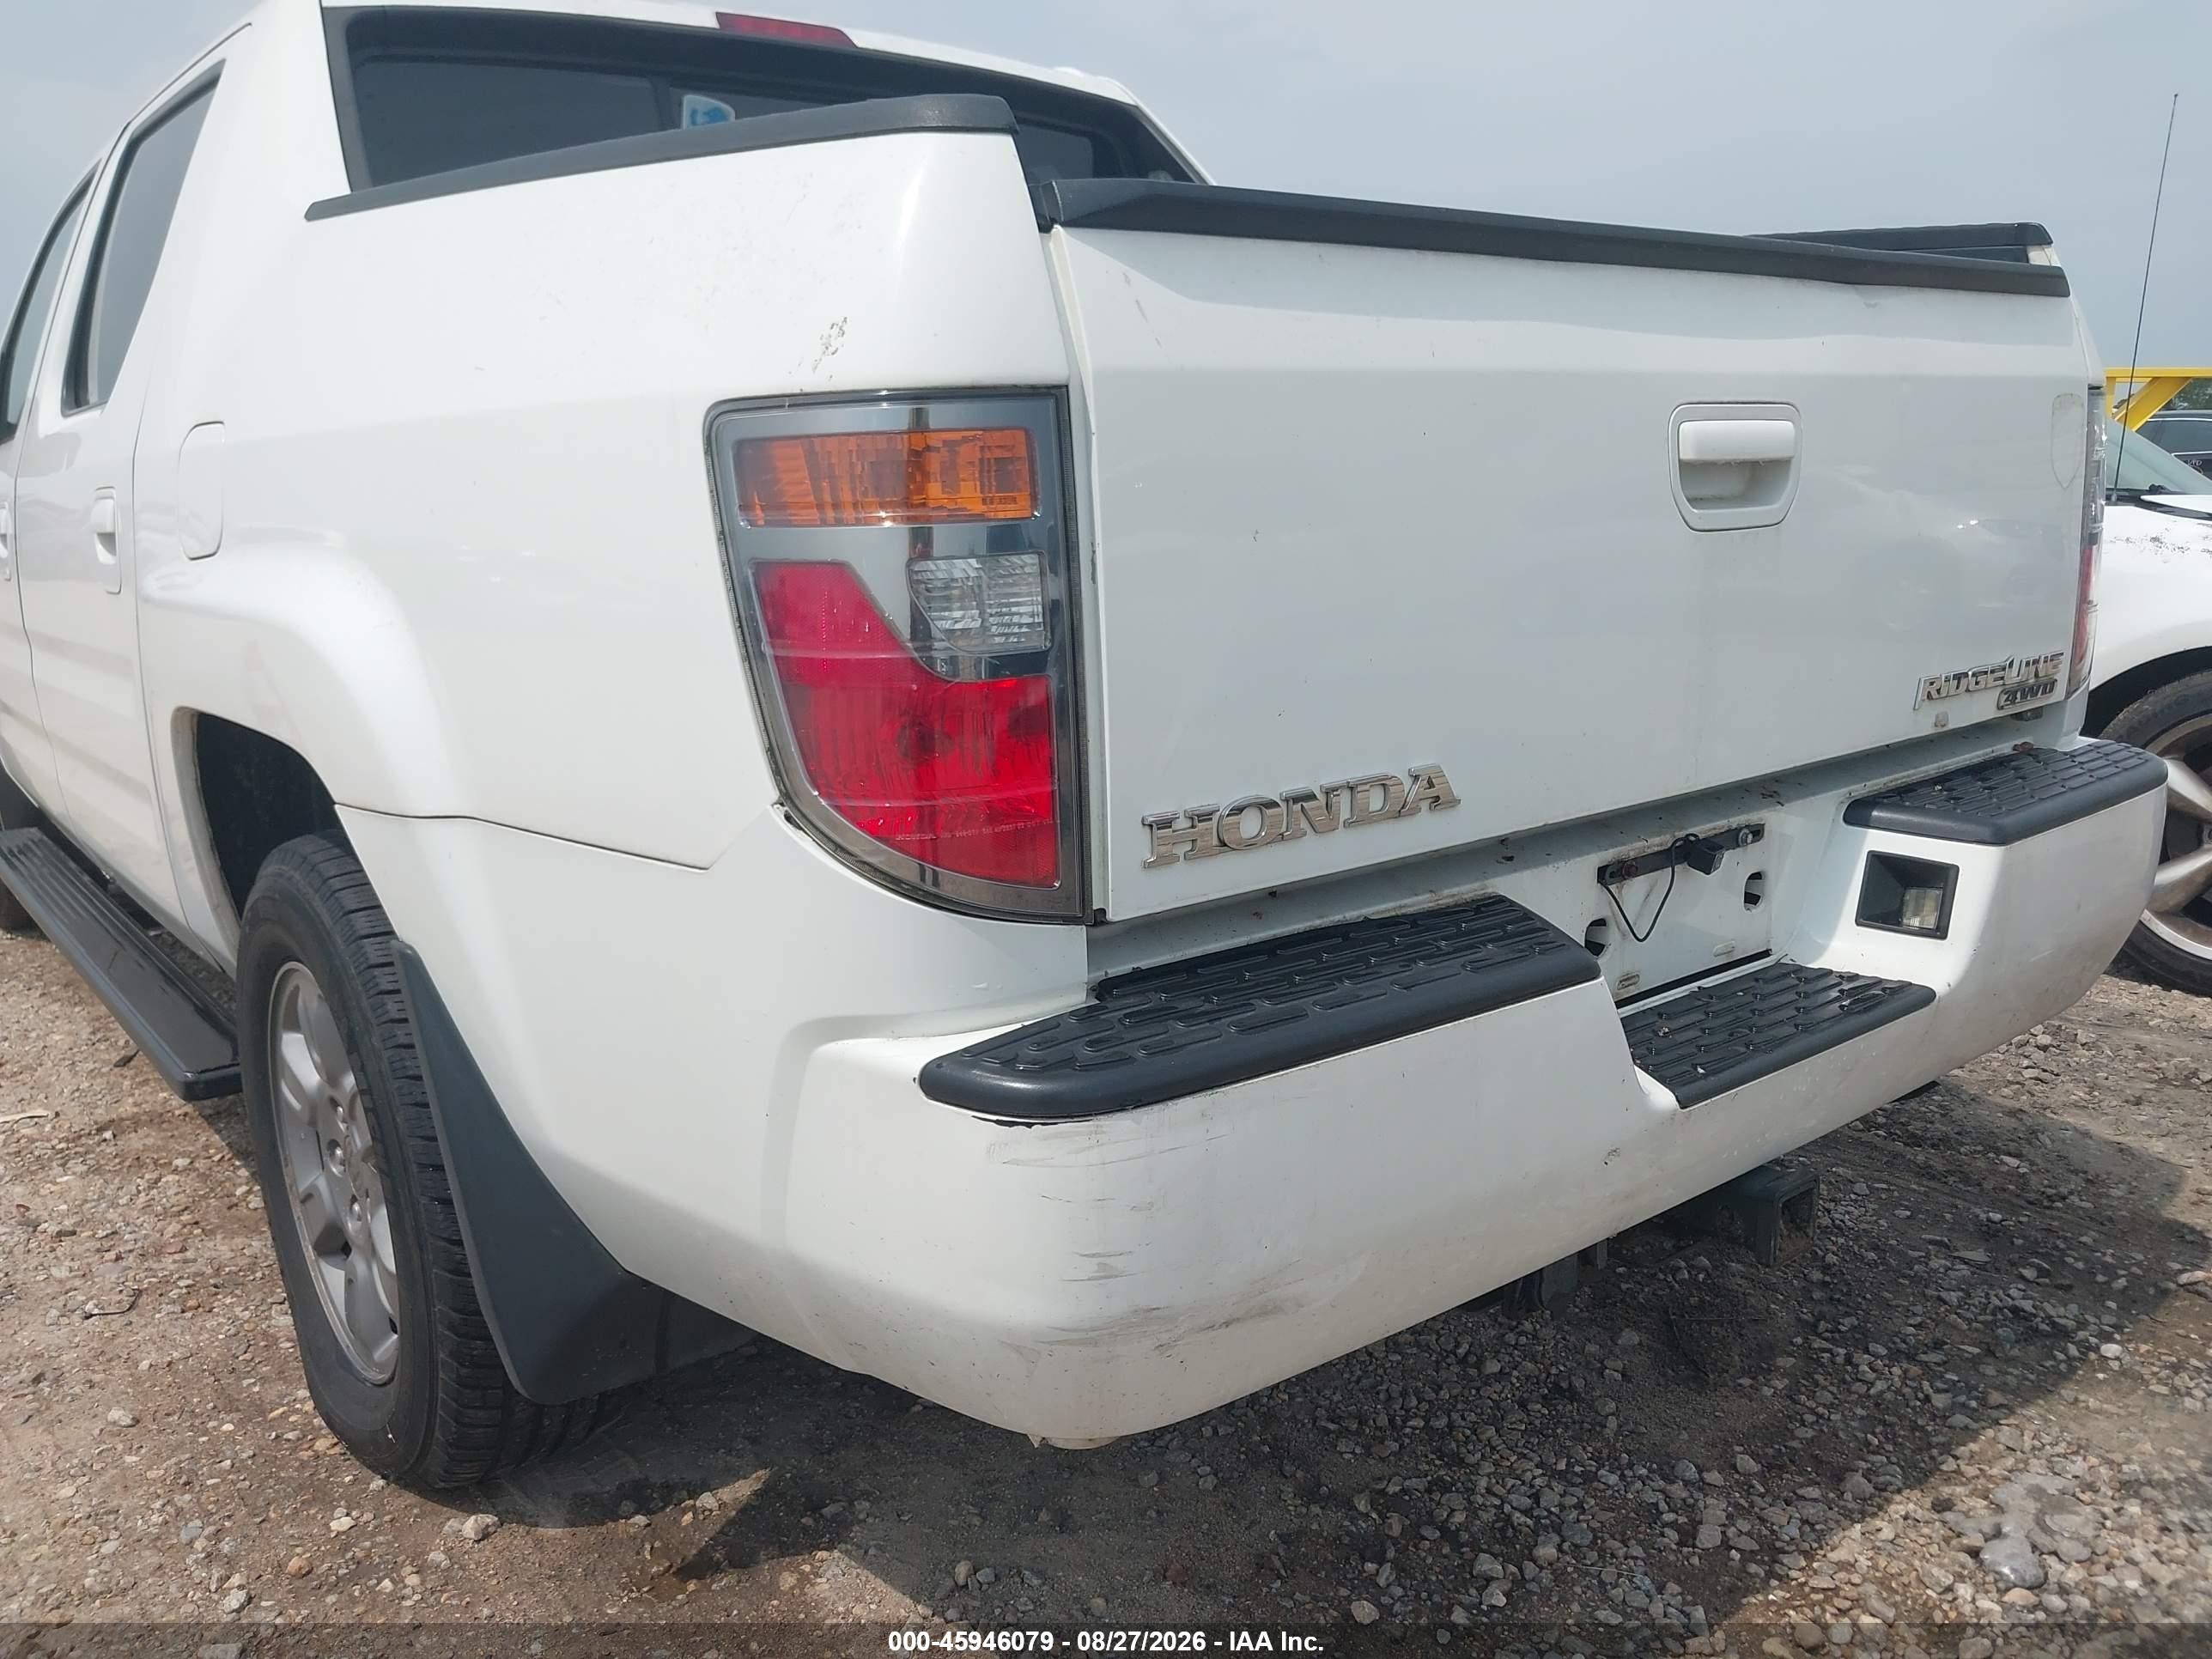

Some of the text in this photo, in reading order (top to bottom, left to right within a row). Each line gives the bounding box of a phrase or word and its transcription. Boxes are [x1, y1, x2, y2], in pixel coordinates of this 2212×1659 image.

[1913, 652, 2064, 710] RIDGELINE
[2001, 679, 2057, 708] 4WD
[1140, 763, 1462, 869] HONDA
